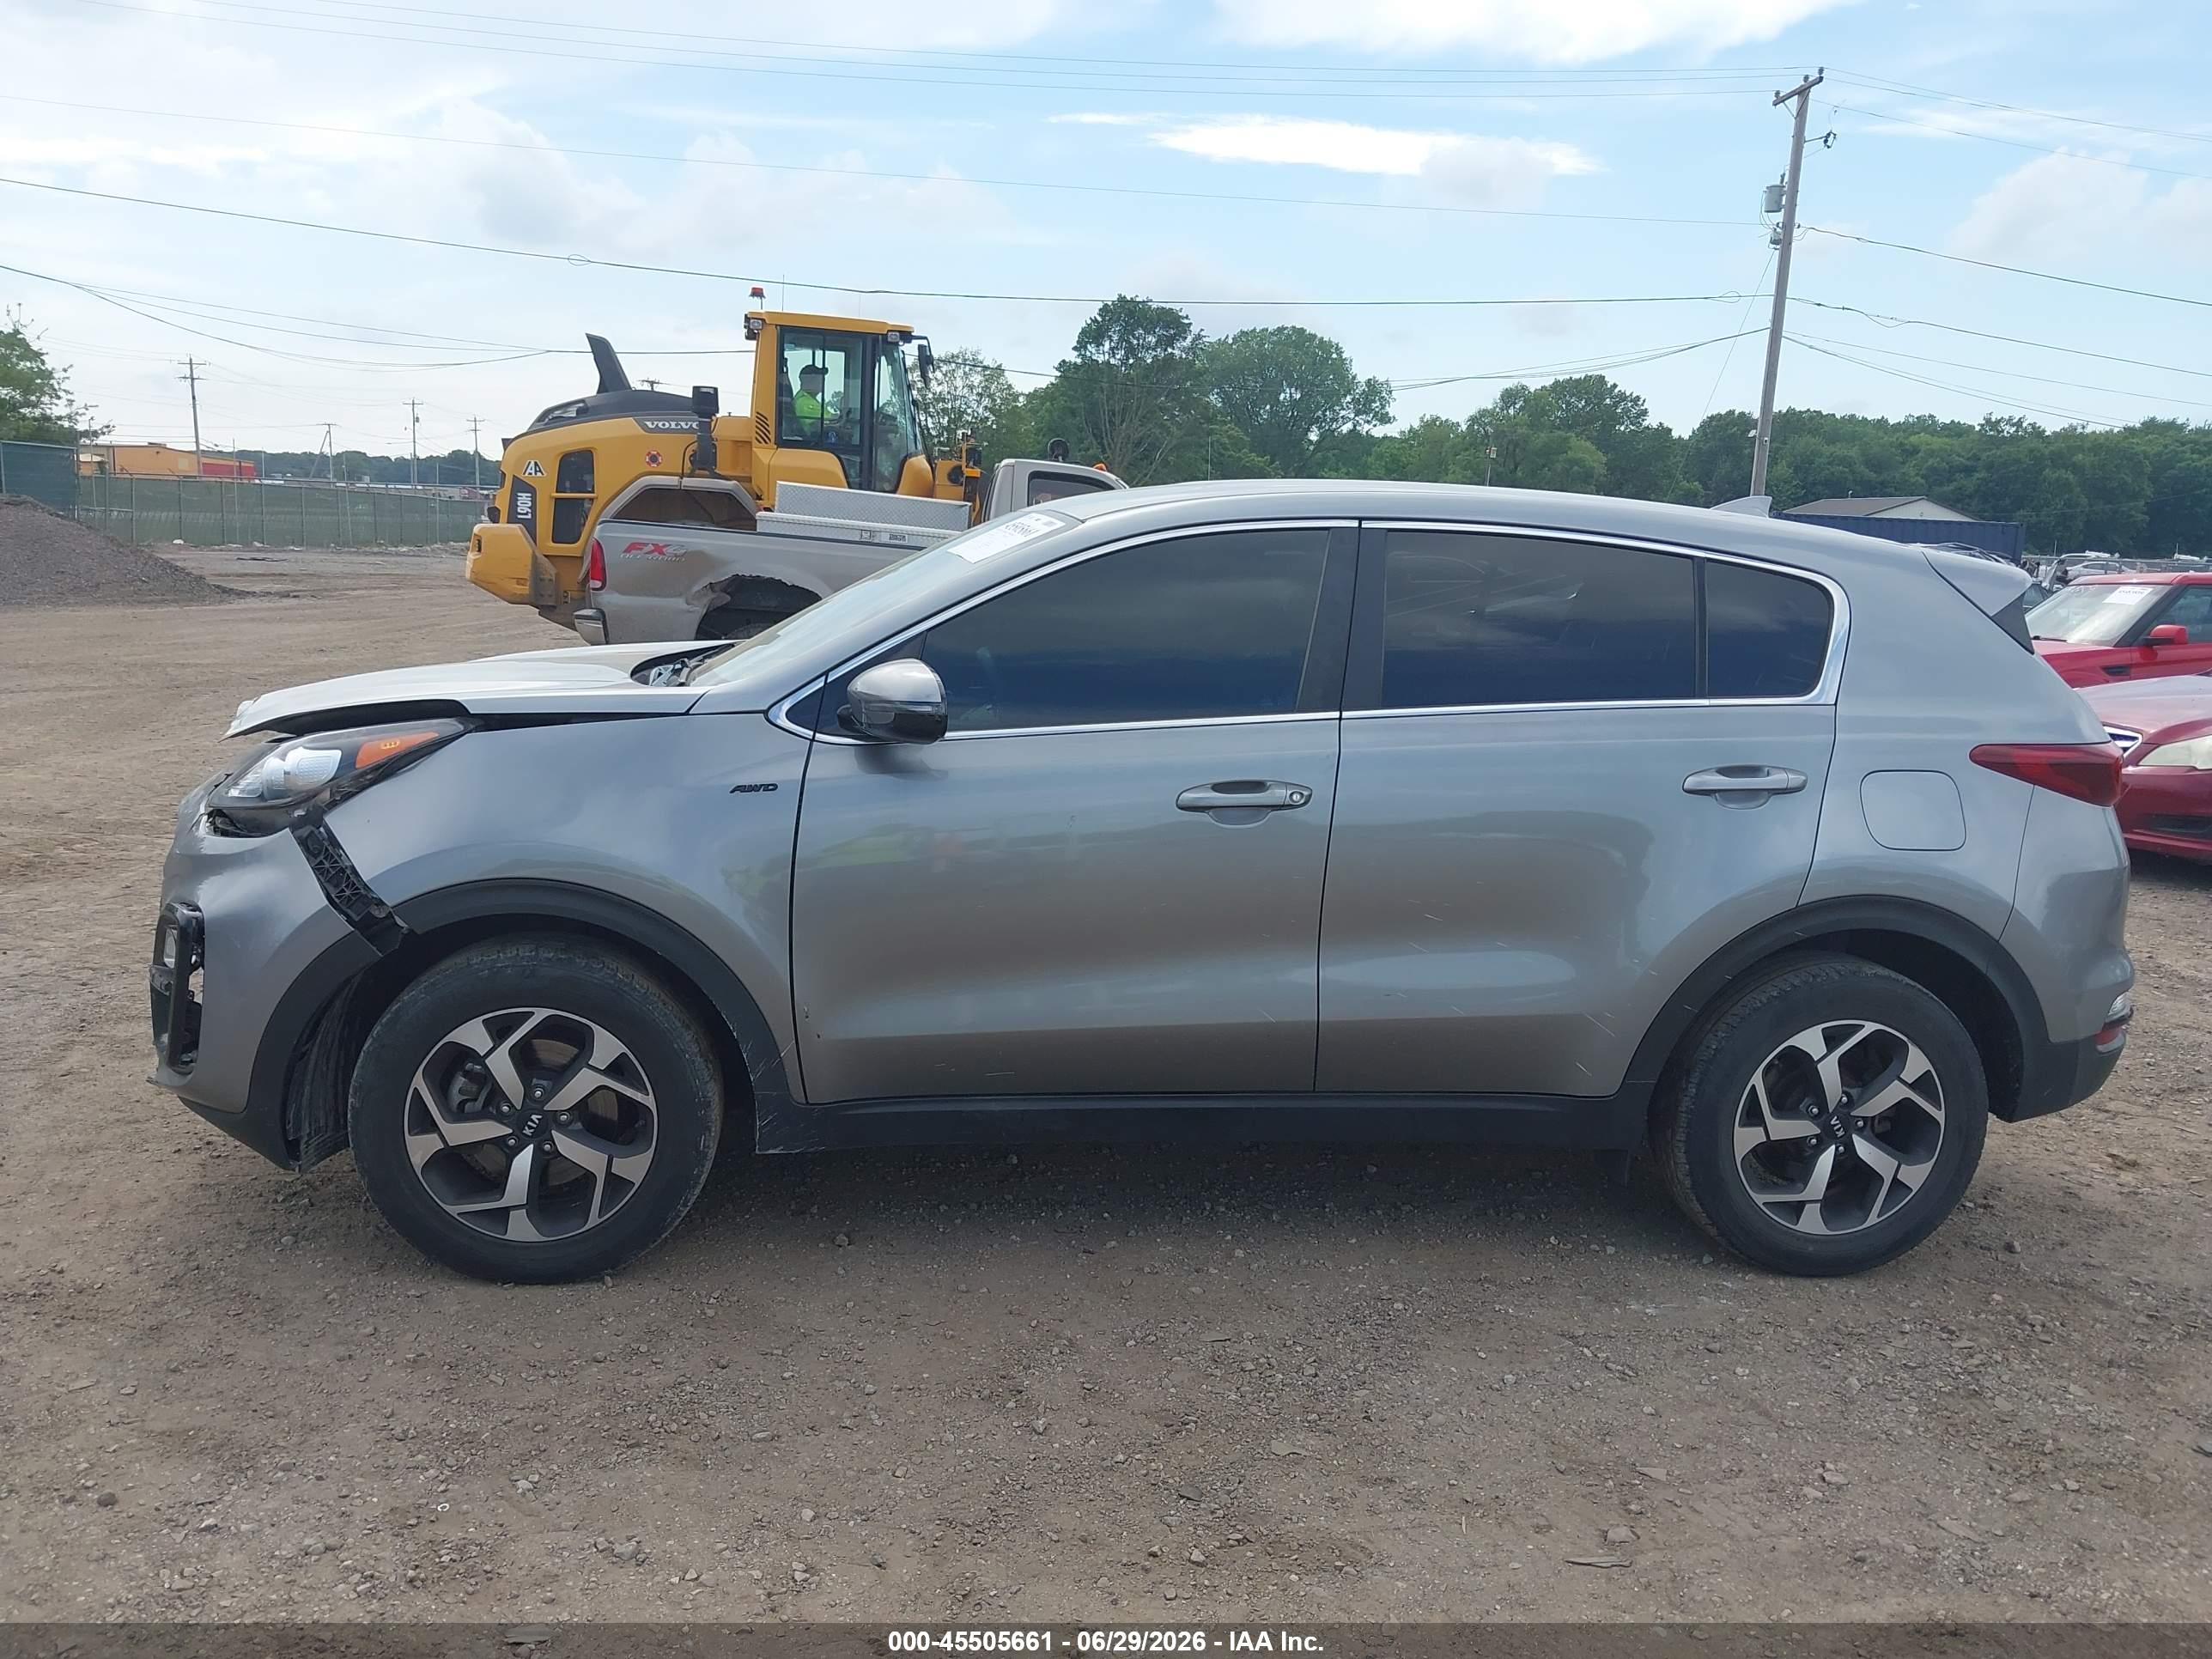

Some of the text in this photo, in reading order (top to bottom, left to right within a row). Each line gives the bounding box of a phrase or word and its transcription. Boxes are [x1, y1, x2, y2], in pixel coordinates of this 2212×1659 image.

[517, 492, 532, 520] L90H
[729, 783, 779, 793] AWD
[522, 1115, 543, 1136] KIA
[1830, 1115, 1845, 1138] KIA
